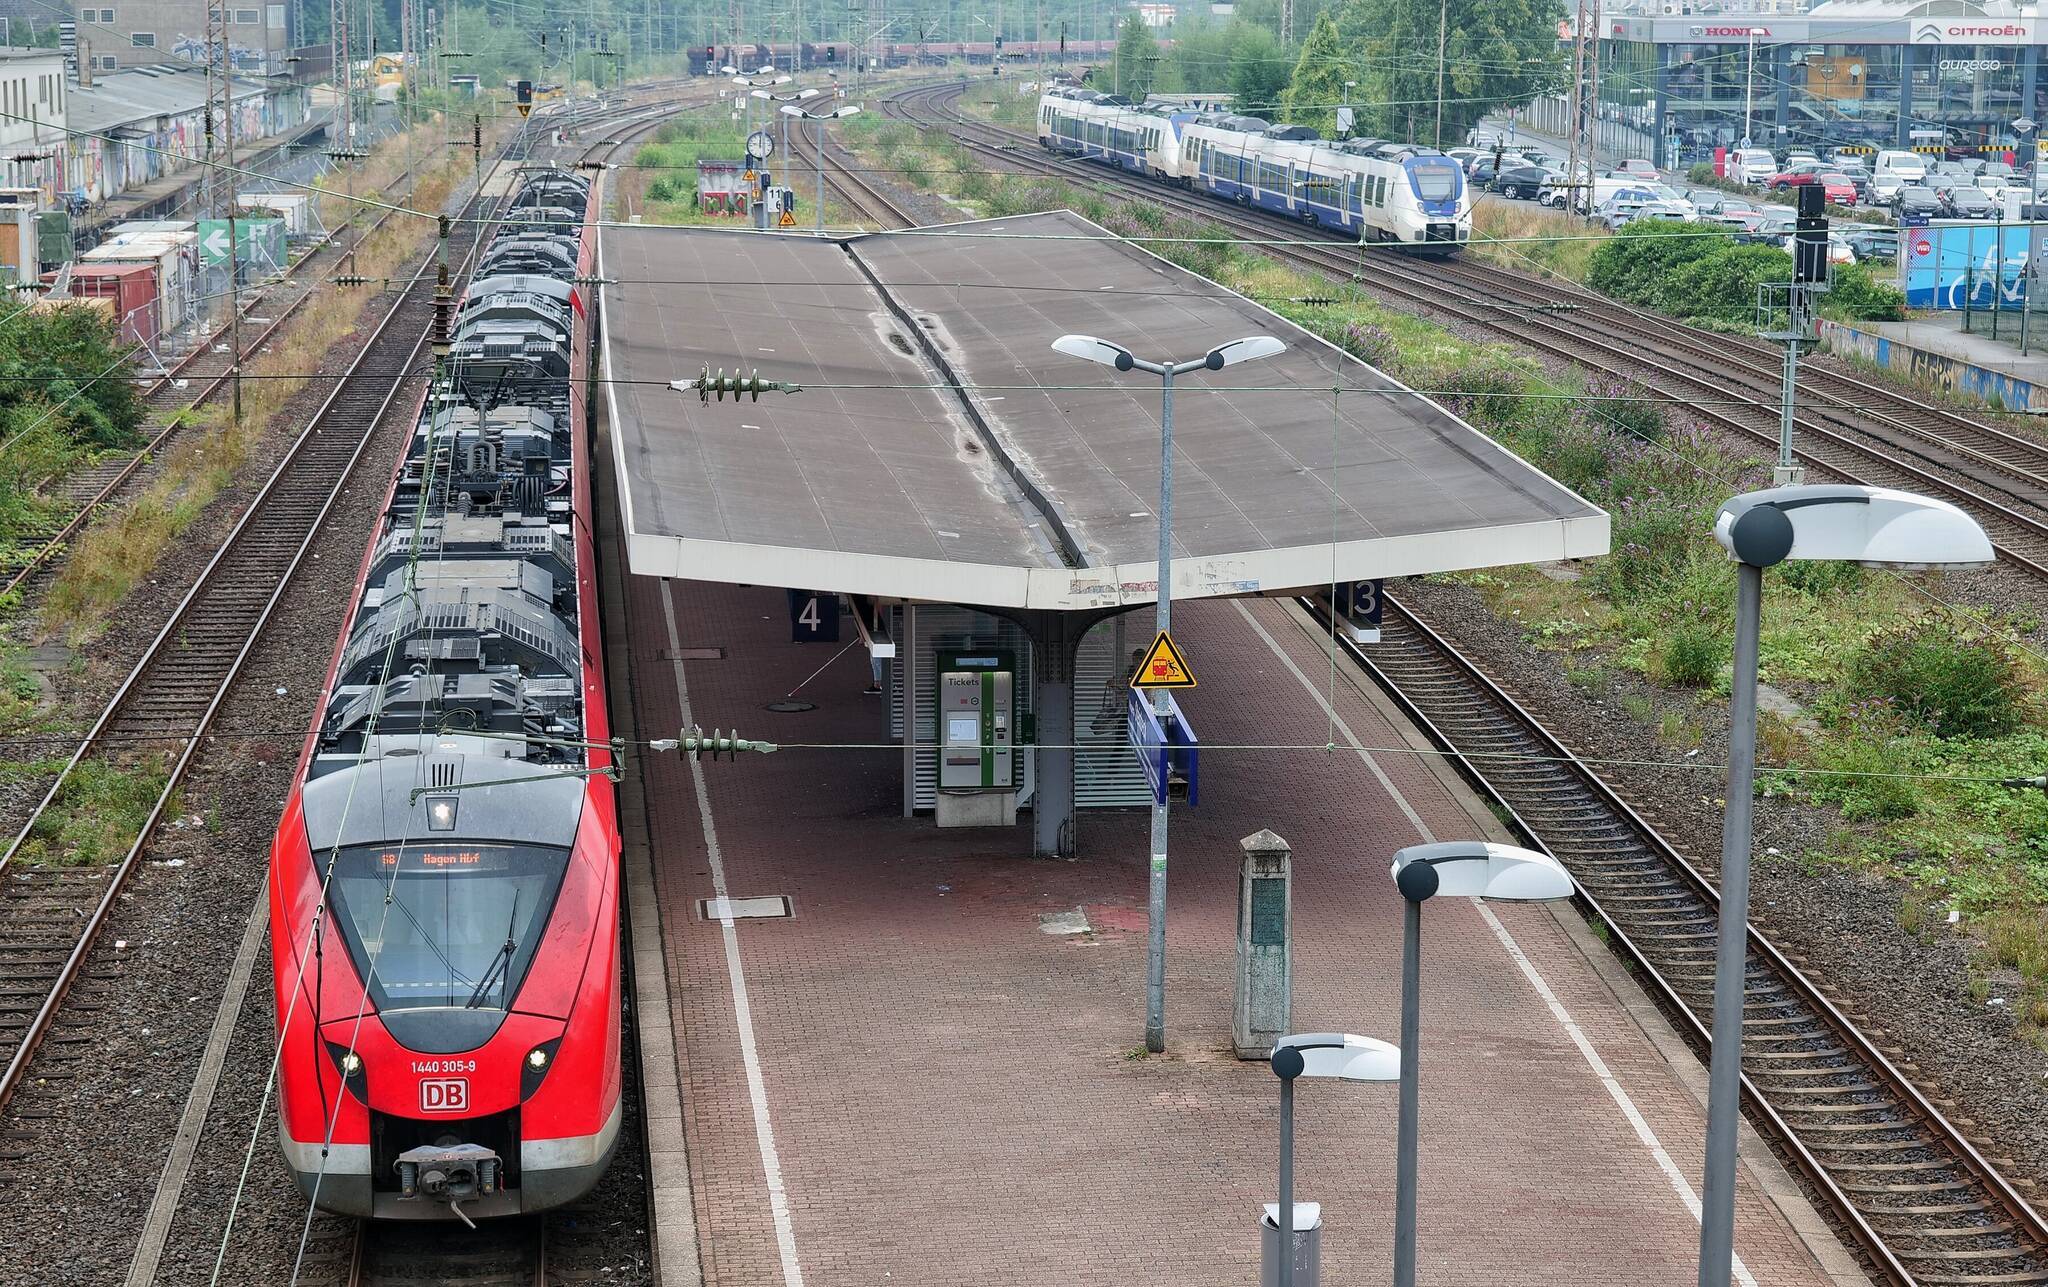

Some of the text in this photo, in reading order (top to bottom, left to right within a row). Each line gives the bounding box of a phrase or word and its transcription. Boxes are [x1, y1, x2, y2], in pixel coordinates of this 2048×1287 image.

[769, 189, 780, 199] 11
[1354, 580, 1376, 615] 3
[798, 597, 821, 632] 4
[948, 678, 980, 687] Tickets
[382, 852, 480, 866] S8 Hagen Hbf
[411, 1060, 476, 1073] 1440 305-9
[426, 1084, 463, 1107] DB
